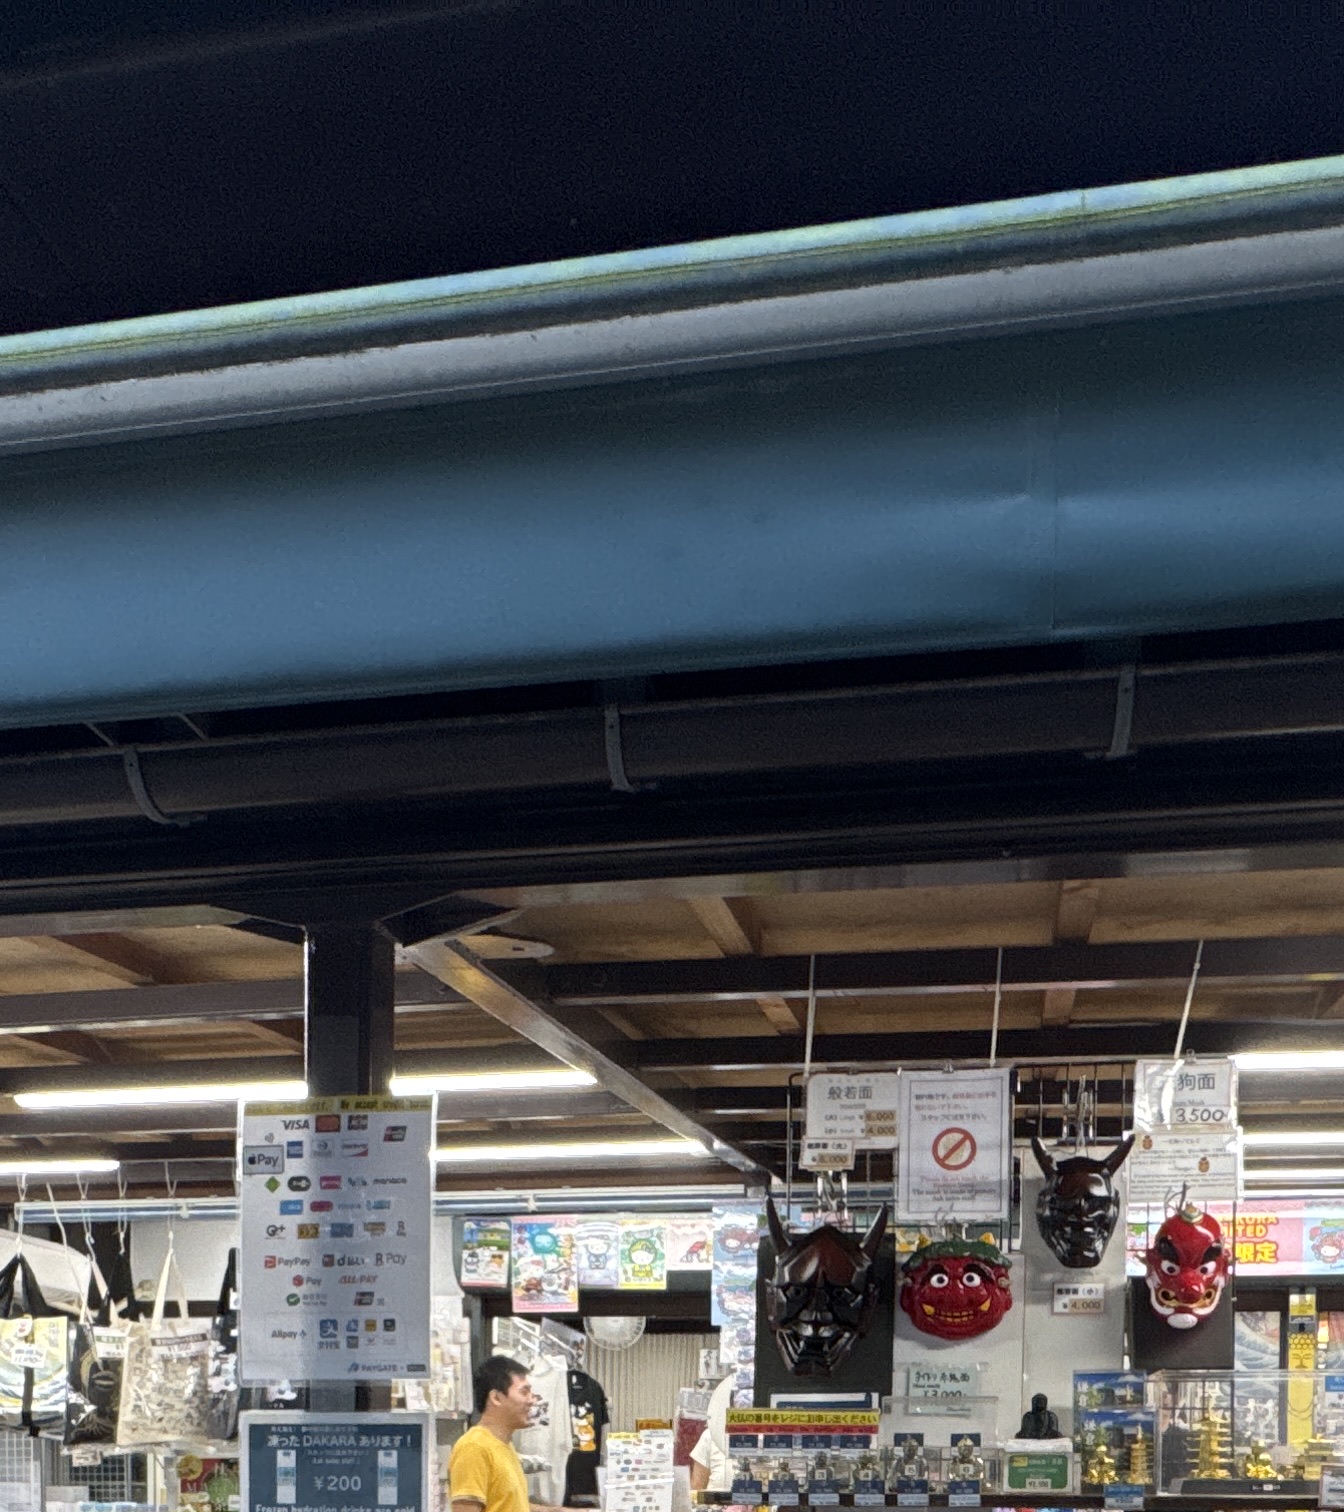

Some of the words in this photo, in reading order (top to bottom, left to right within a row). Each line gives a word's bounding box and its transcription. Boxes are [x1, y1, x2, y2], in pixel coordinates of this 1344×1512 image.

[827, 1086, 873, 1100] 般若面
[283, 1119, 309, 1130] VISA
[257, 1153, 279, 1167] Pay
[278, 1256, 310, 1267] PayPay
[386, 1253, 407, 1265] Pay
[303, 1434, 356, 1446] DAKARA
[314, 1475, 362, 1491] ¥200
